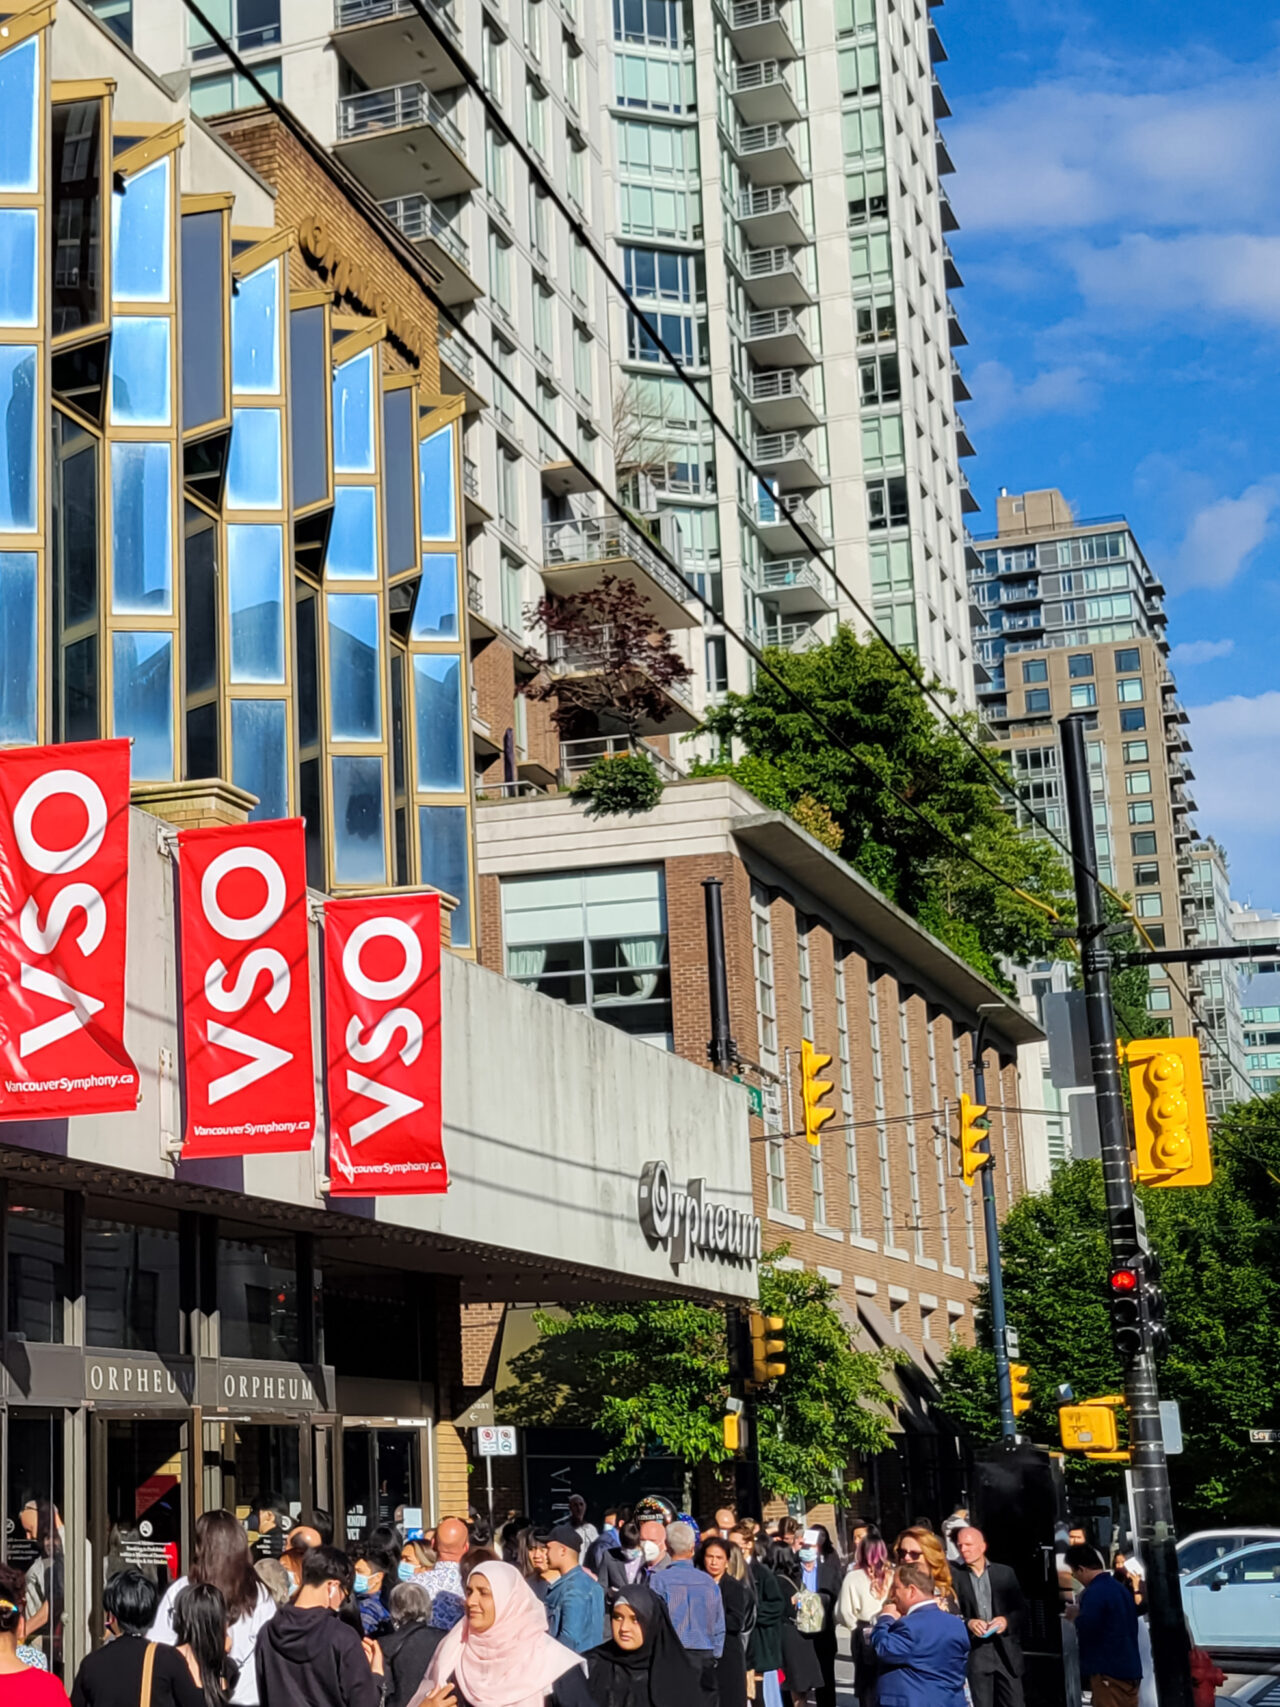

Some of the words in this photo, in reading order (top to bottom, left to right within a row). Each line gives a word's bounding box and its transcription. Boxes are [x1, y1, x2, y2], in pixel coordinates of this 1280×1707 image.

[13, 769, 108, 1058] VSO
[201, 846, 294, 1106] VSO
[342, 916, 424, 1147] VSO
[5, 1074, 134, 1092] VancouverSymphony.ca
[194, 1121, 310, 1137] VancouverSymphony.ca
[638, 1160, 761, 1264] Orpheum
[91, 1365, 194, 1394] ORPHEUM
[224, 1374, 313, 1400] ORPHEUM
